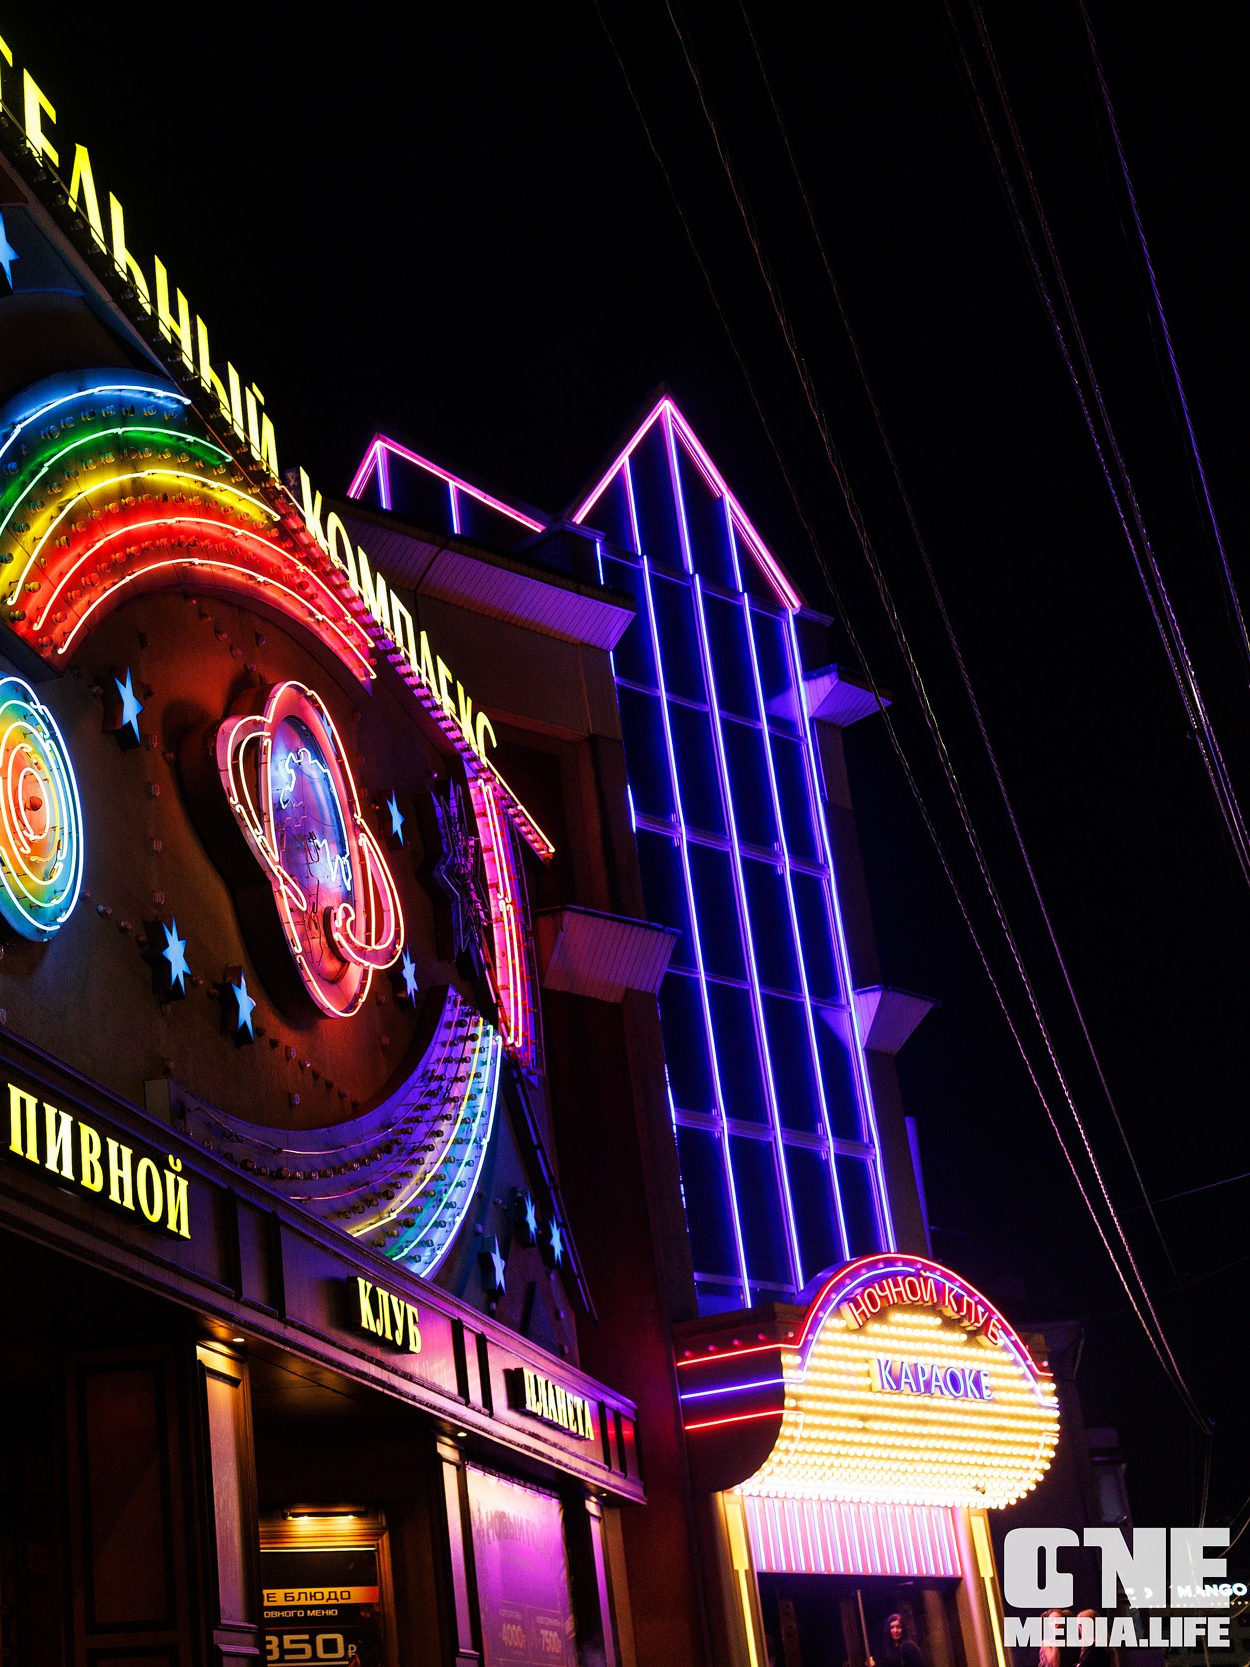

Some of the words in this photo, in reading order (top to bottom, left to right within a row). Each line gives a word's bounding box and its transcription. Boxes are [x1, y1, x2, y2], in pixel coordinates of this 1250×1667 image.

[7, 1082, 191, 1240] ПИВНОЙ
[357, 1276, 422, 1354] КЛУБ
[523, 1367, 595, 1441] ПЛАНЕТА
[848, 1269, 938, 1329] НОЧНОЙ
[943, 1282, 1002, 1347] КЛУБ
[877, 1358, 994, 1401] КАРАОКЕ
[284, 1590, 351, 1603] БЛЮДО
[307, 1608, 338, 1618] МЕНЮ
